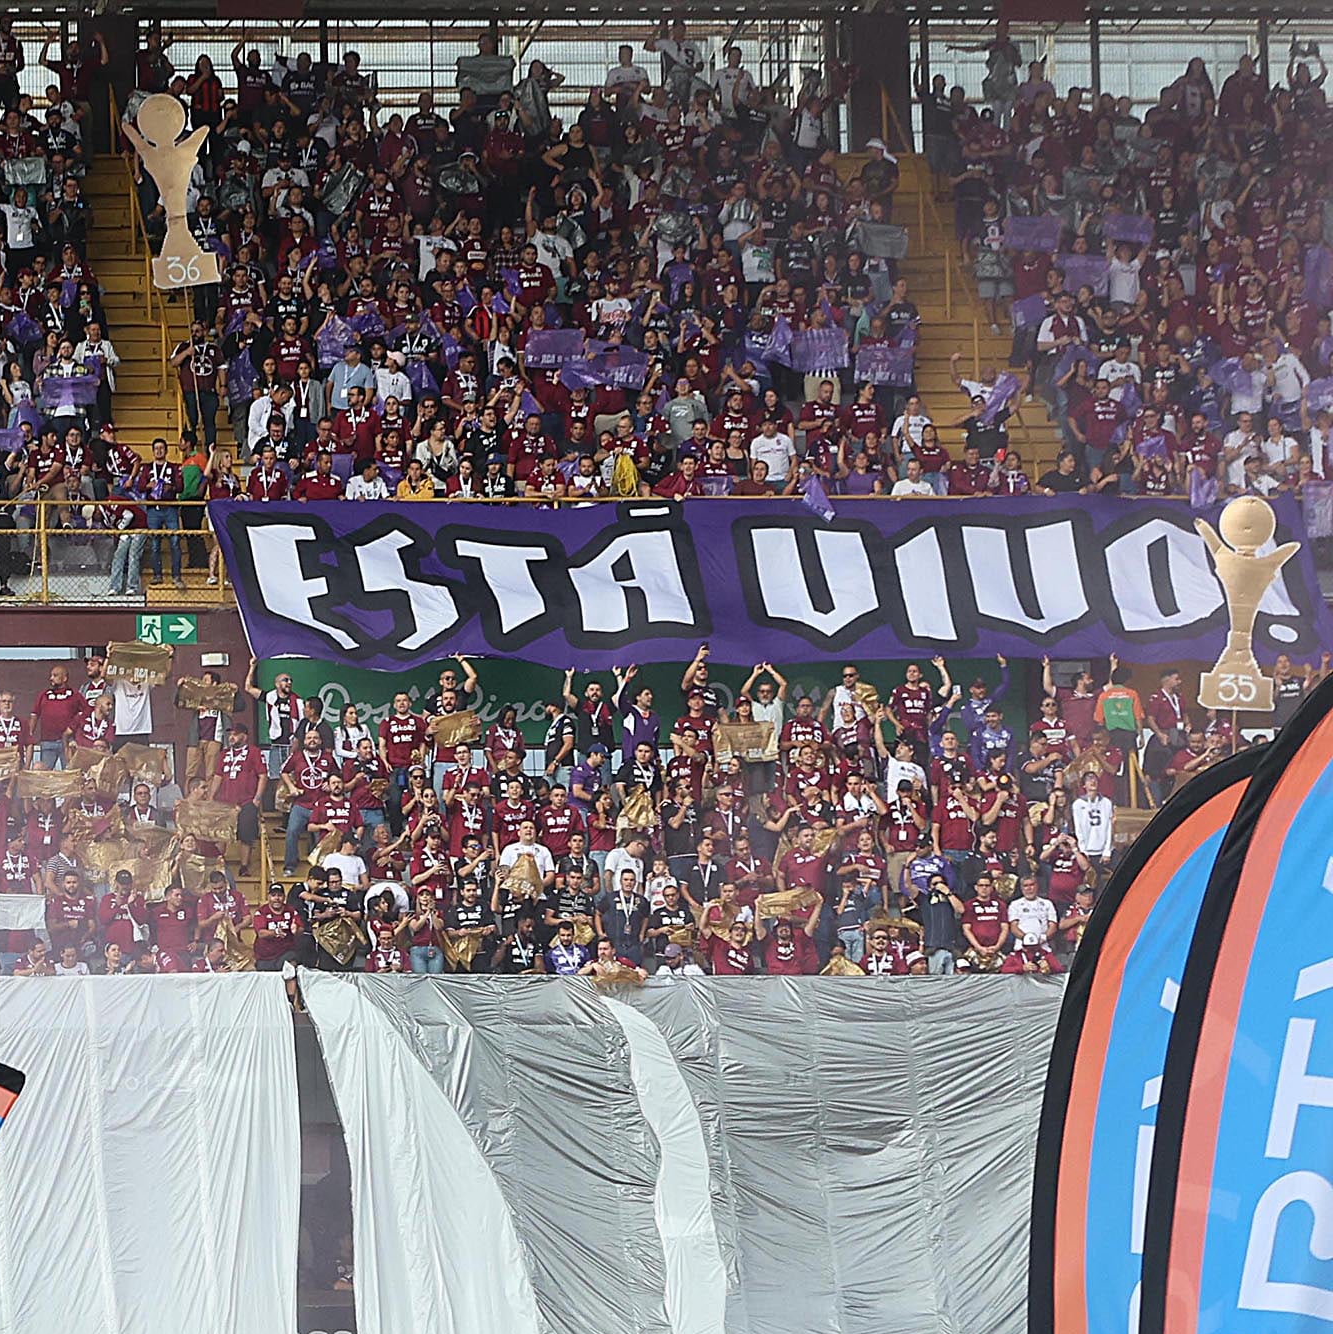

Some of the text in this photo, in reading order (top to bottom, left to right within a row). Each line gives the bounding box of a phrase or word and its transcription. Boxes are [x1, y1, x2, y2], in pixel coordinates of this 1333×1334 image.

[167, 255, 201, 283] 36
[245, 508, 695, 652] ESTÁ
[1218, 673, 1257, 702] 35
